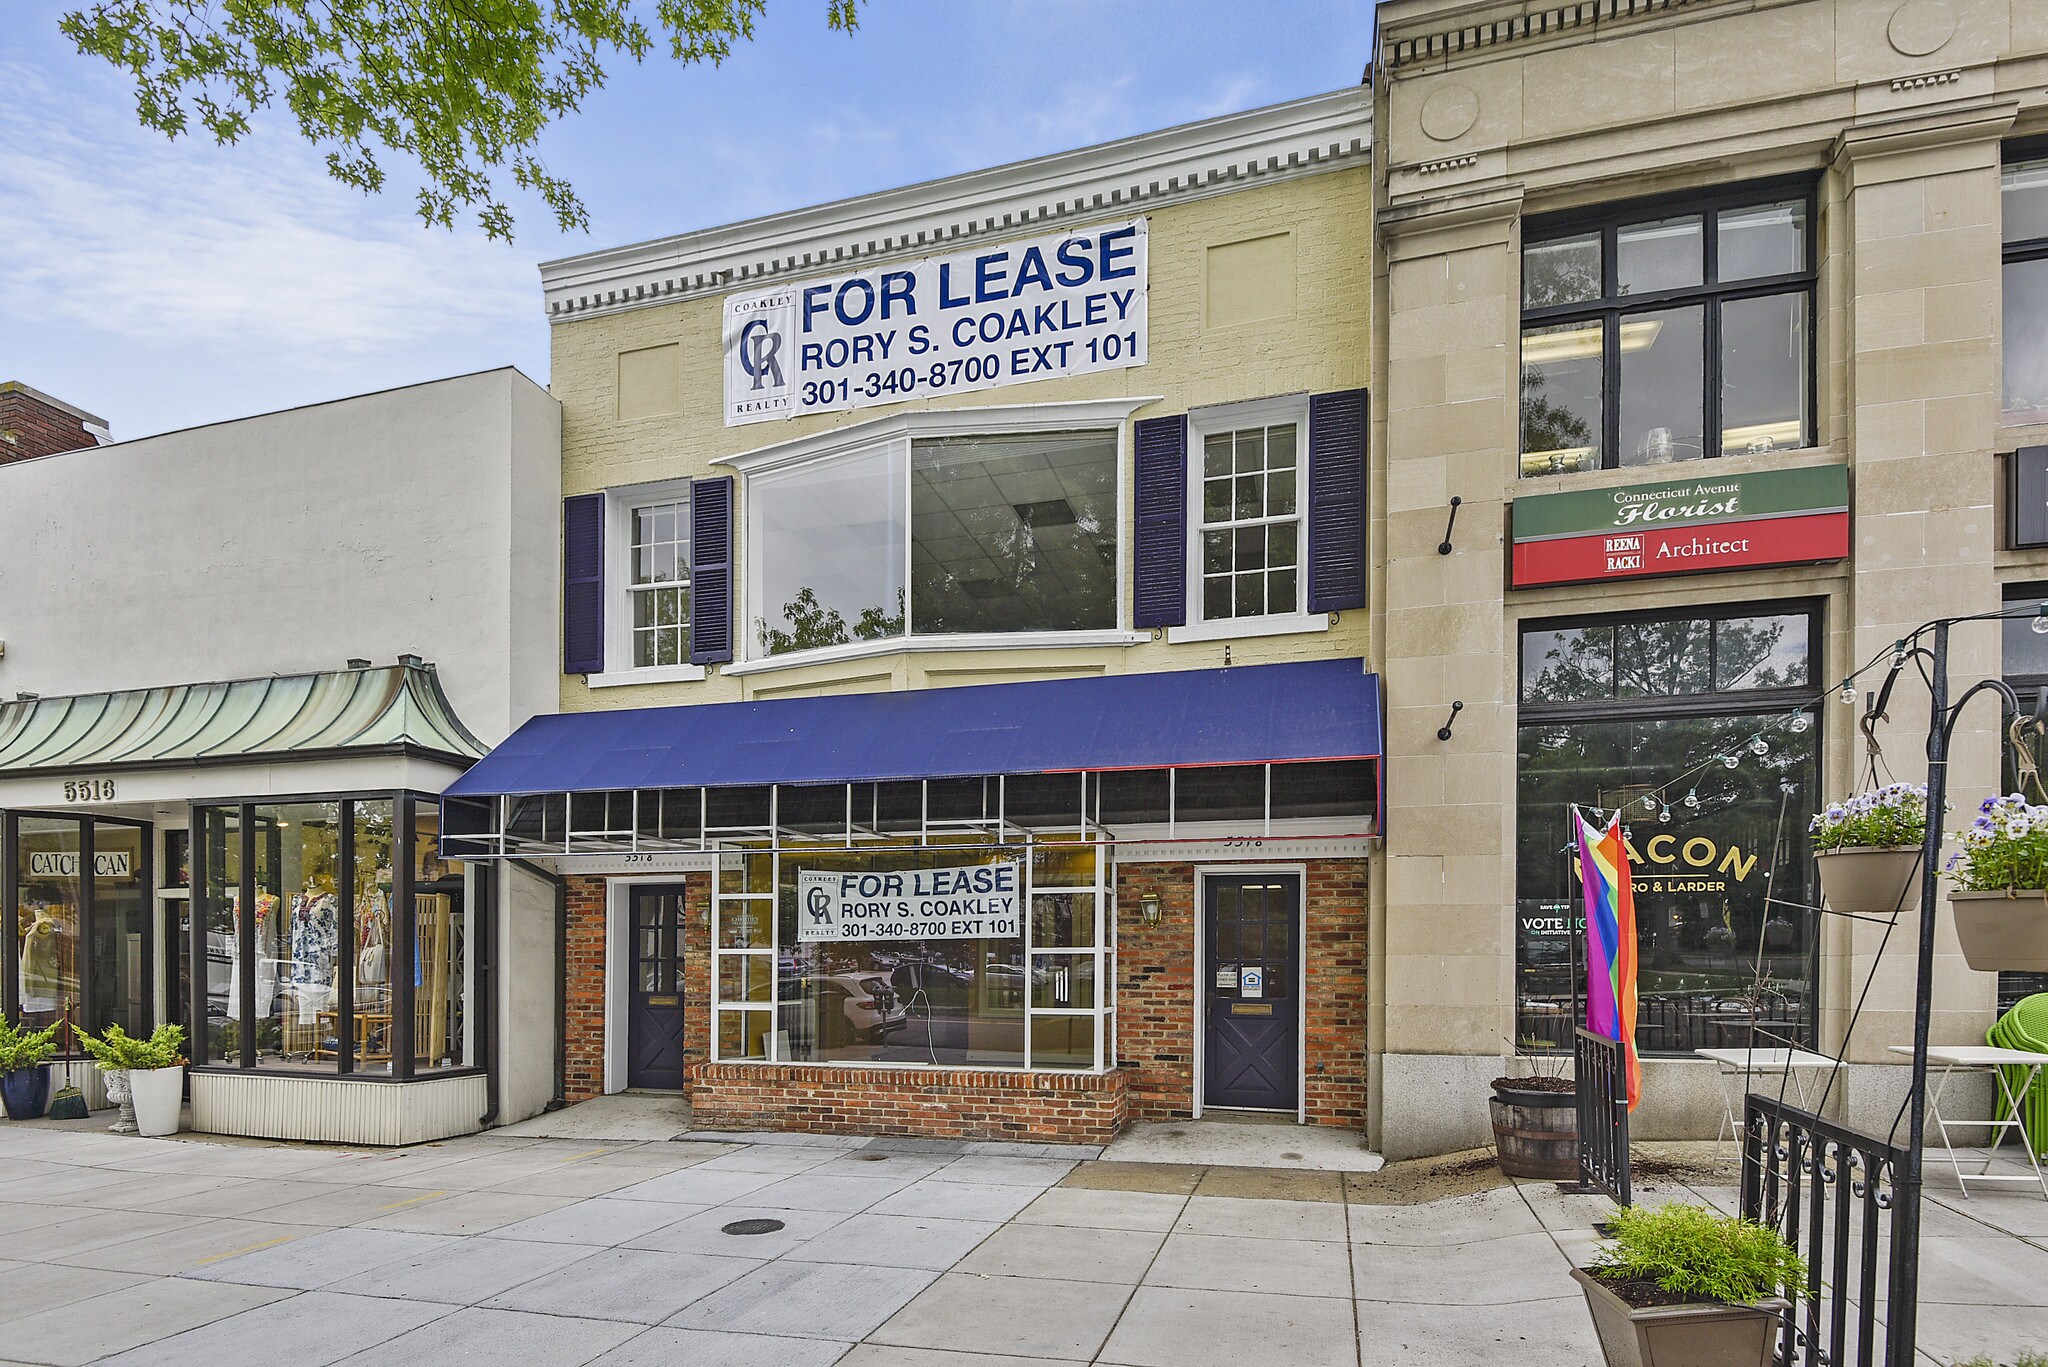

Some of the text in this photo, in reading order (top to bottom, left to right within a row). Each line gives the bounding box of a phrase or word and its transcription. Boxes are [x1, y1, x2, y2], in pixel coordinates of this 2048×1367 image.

[802, 226, 1136, 333] FOR LEASE
[734, 295, 792, 313] COAKLEY
[802, 289, 1135, 371] RORY S. COAKLEY
[802, 331, 1137, 406] 301-340-8700 EXT 101
[737, 397, 789, 413] REALTY
[1613, 483, 1740, 504] Connecticut Avenue
[1613, 496, 1740, 525] Florist
[1605, 537, 1640, 552] REENA
[1655, 537, 1750, 559] Architect
[1607, 555, 1641, 570] RACKI
[31, 853, 128, 875] CATCH CAN
[1574, 834, 1758, 883] ACON
[840, 866, 1013, 898] FOR LEASE
[1652, 881, 1663, 892] &
[1668, 881, 1725, 893] LARDER
[841, 898, 1013, 919] RORY S. COAKLEY
[842, 919, 1015, 937] 301-340-8700 EXT 101
[1522, 918, 1564, 929] VOTE
